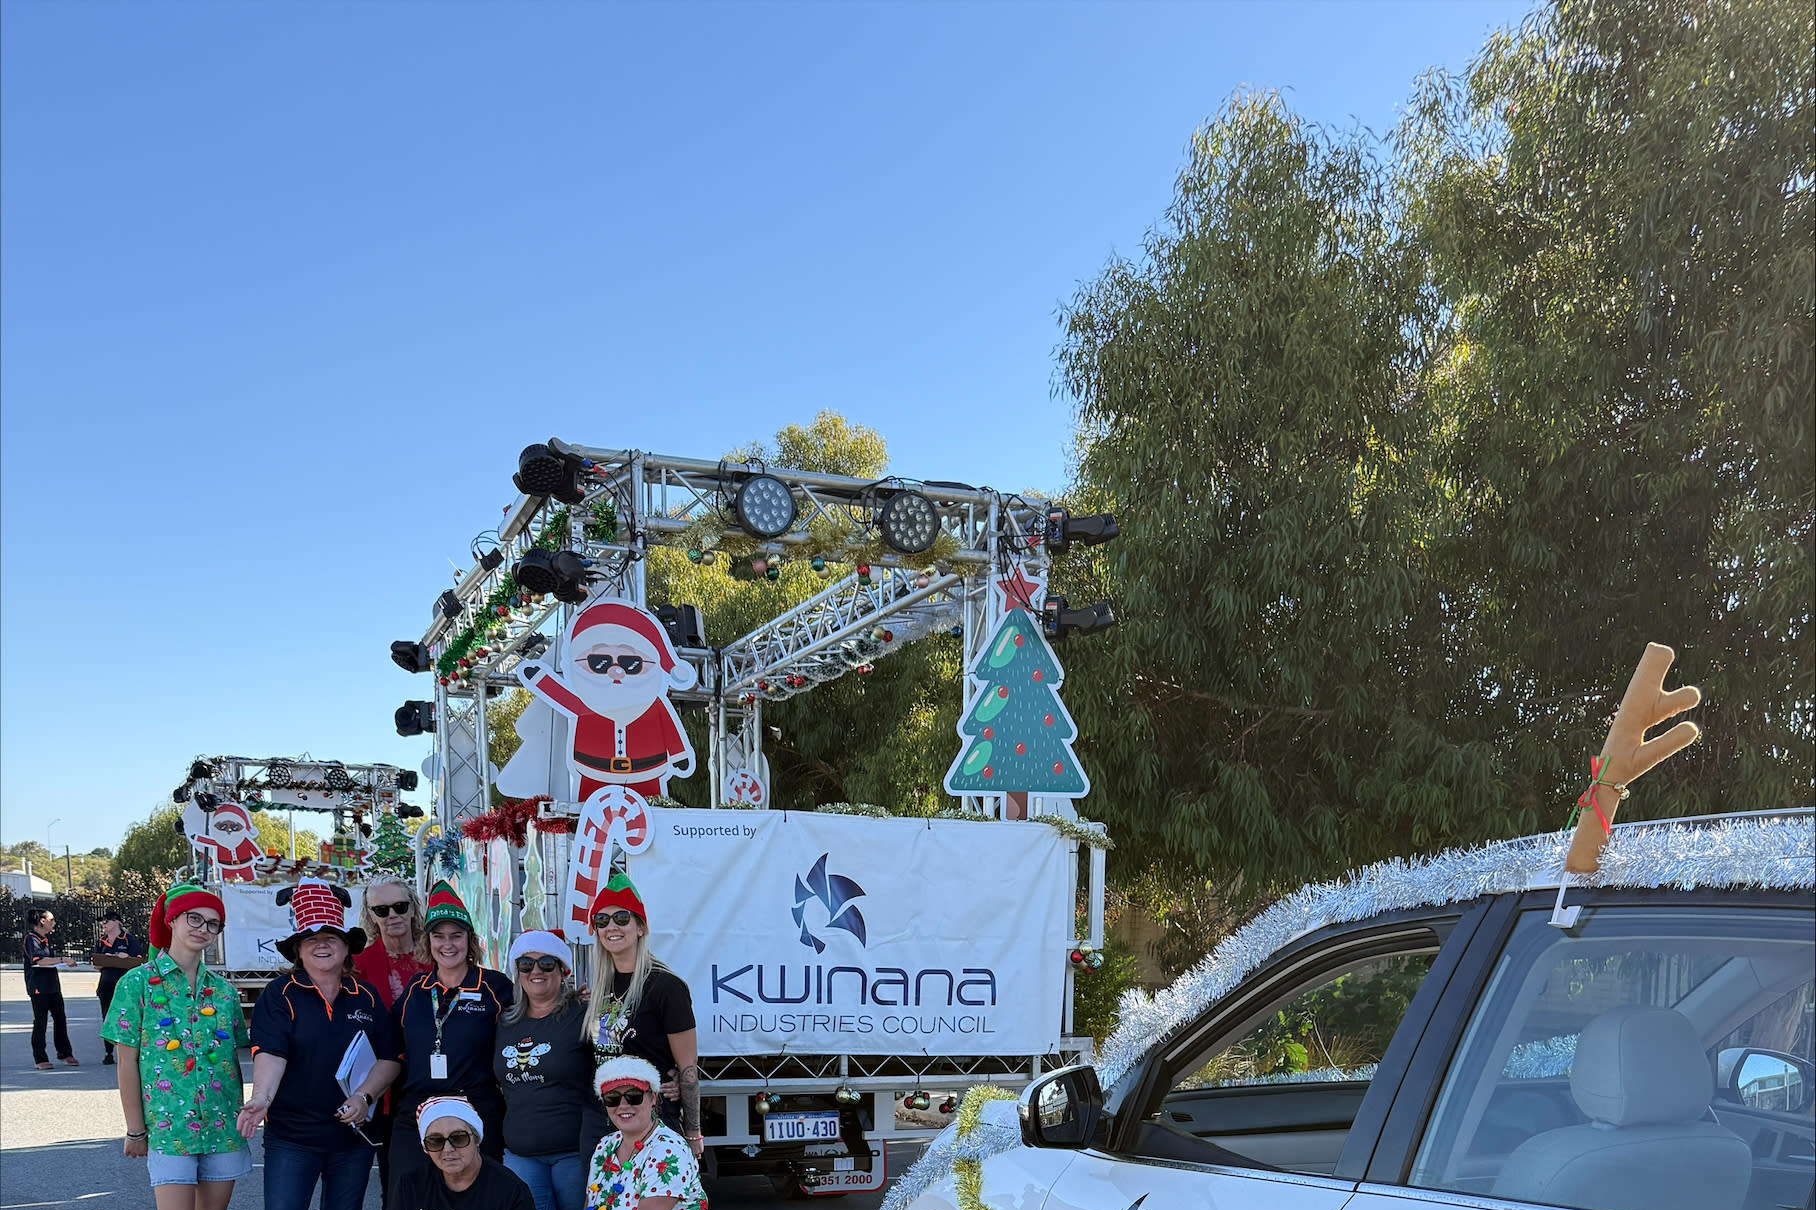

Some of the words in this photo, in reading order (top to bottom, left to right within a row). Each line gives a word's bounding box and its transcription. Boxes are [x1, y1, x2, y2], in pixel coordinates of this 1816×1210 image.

[673, 824, 739, 839] Supported
[742, 824, 757, 840] by
[713, 1014, 874, 1034] INDUSTRIES
[882, 1015, 996, 1035] COUNCIL
[844, 1175, 873, 1185] 2000
